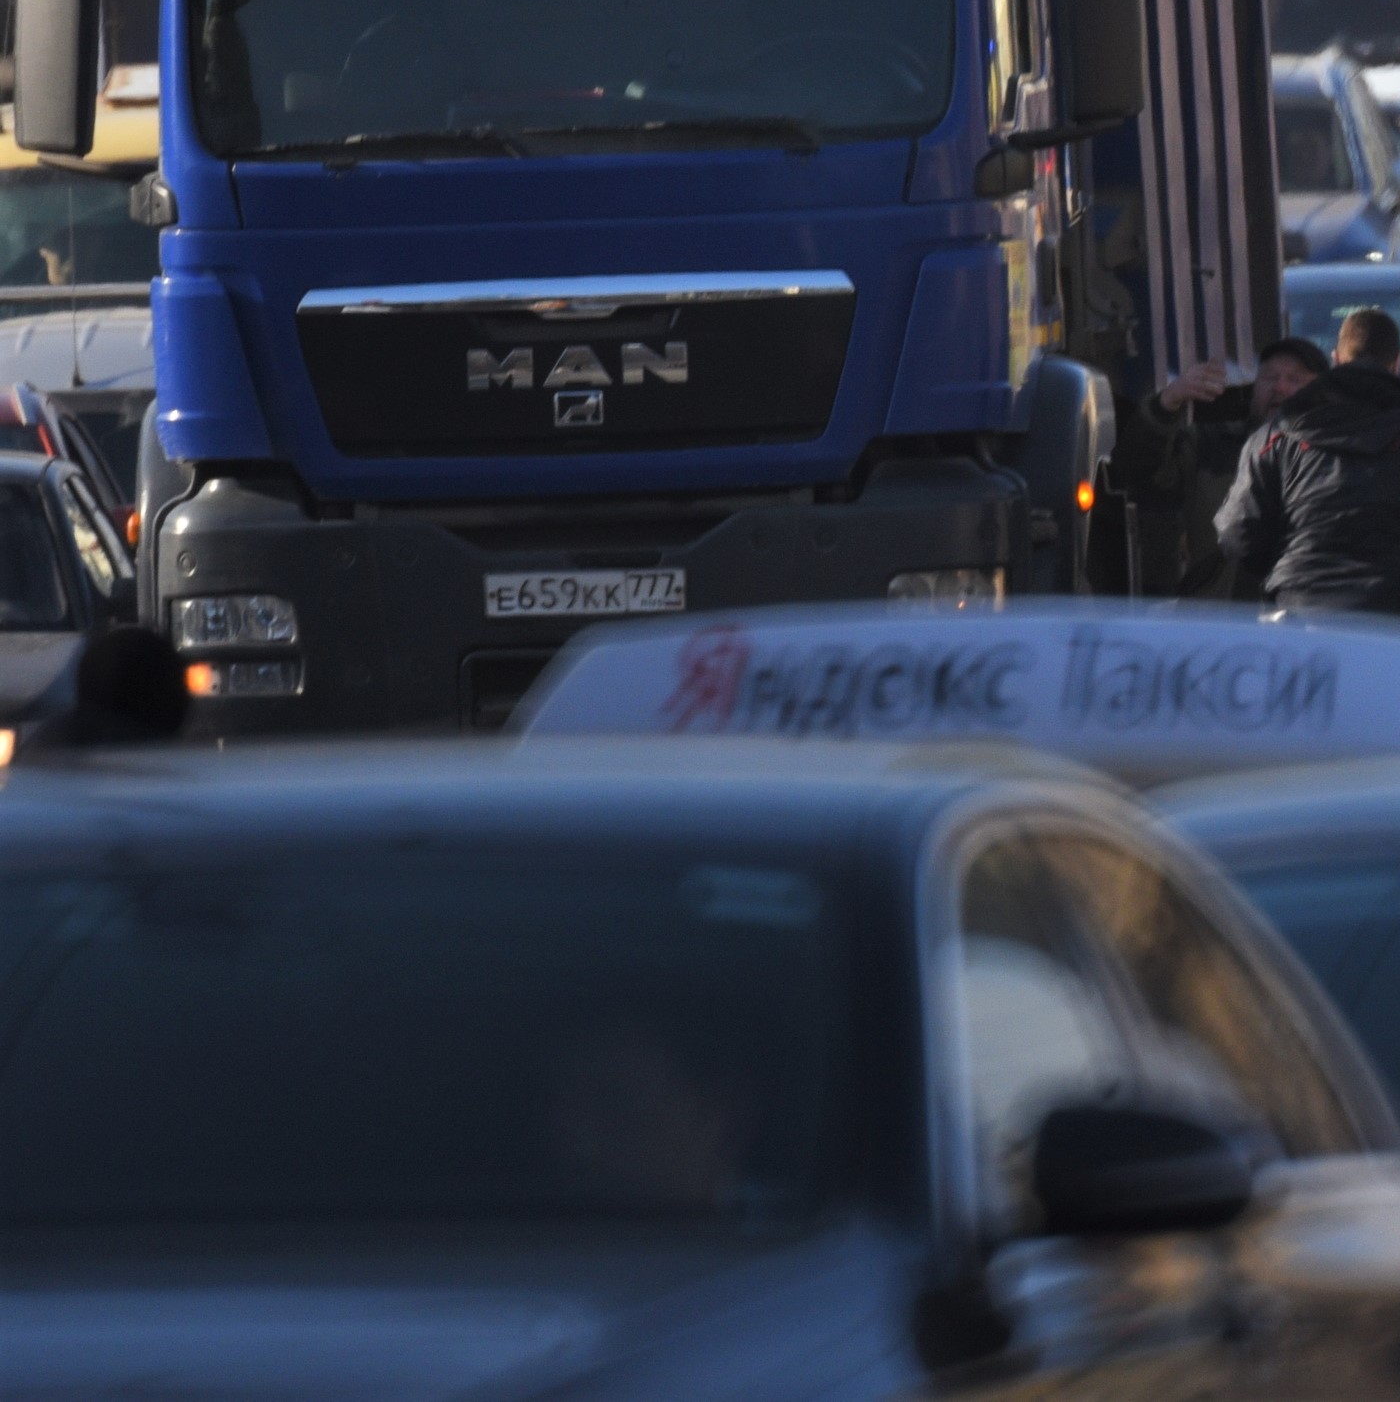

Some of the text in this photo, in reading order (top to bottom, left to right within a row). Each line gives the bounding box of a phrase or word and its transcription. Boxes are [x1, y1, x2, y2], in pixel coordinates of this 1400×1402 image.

[466, 341, 688, 391] MAN
[660, 626, 1340, 740] Яндекс Такси
